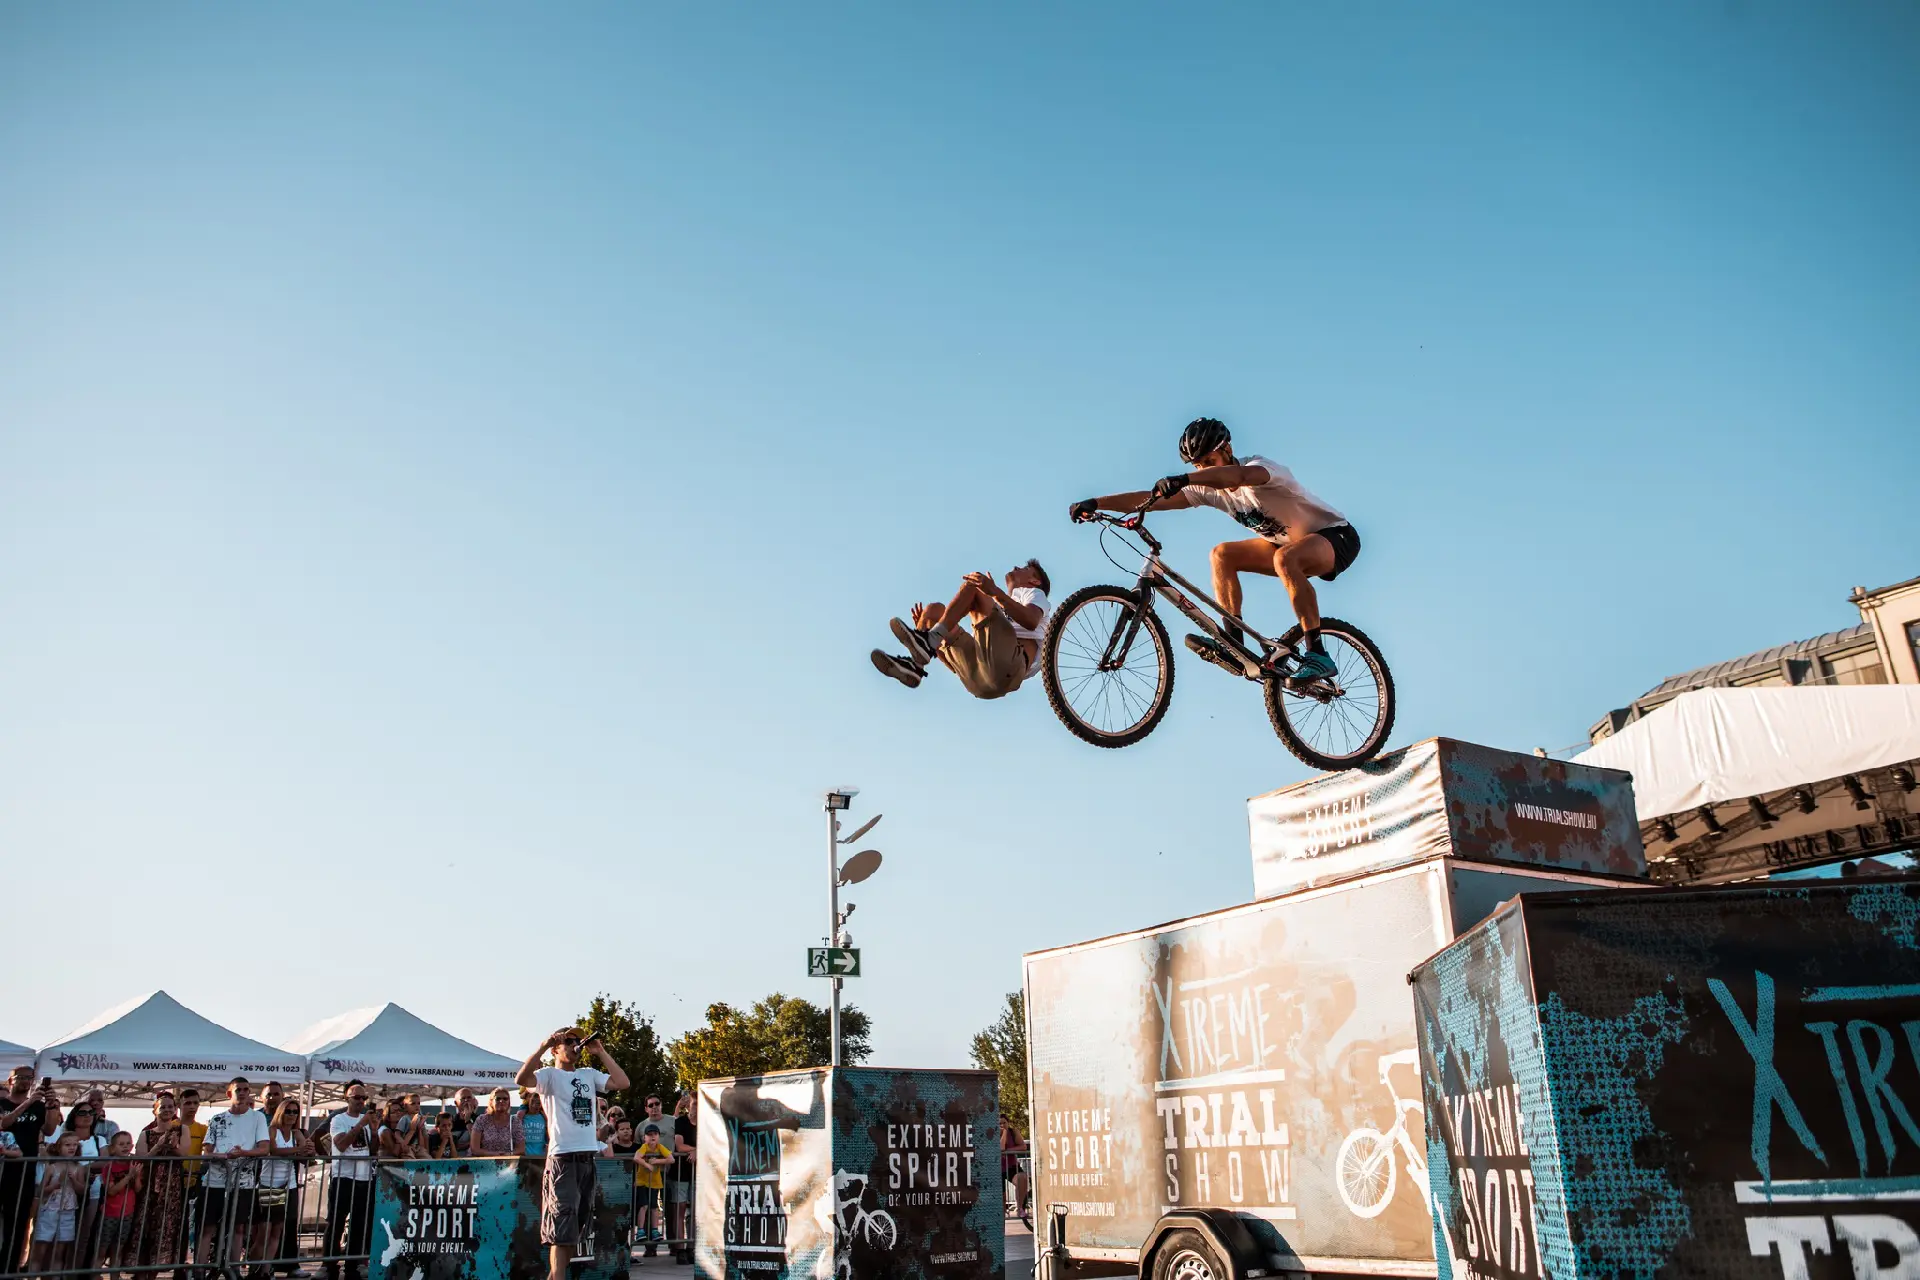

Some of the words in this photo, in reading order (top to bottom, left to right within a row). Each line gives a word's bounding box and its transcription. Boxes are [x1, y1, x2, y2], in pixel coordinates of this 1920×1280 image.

[1514, 801, 1597, 830] WWW.TRIALSHOW.HU
[77, 1062, 120, 1071] BRAND
[78, 1053, 107, 1062] STAR
[133, 1062, 227, 1071] WWW.STARBRAND.HU
[1046, 1107, 1111, 1135] EXTREME
[1156, 1088, 1290, 1150] TRIAL
[728, 1116, 782, 1174] XTREM
[887, 1123, 974, 1149] EXTREME
[1048, 1134, 1112, 1170] SPORT
[888, 1151, 974, 1189] SPORT
[1061, 1173, 1079, 1186] YOUR
[1165, 1149, 1289, 1203] SHOW
[409, 1184, 479, 1206] EXTREME
[906, 1192, 930, 1206] YOUR
[406, 1207, 477, 1238] SPORT
[417, 1242, 437, 1253] YOUR
